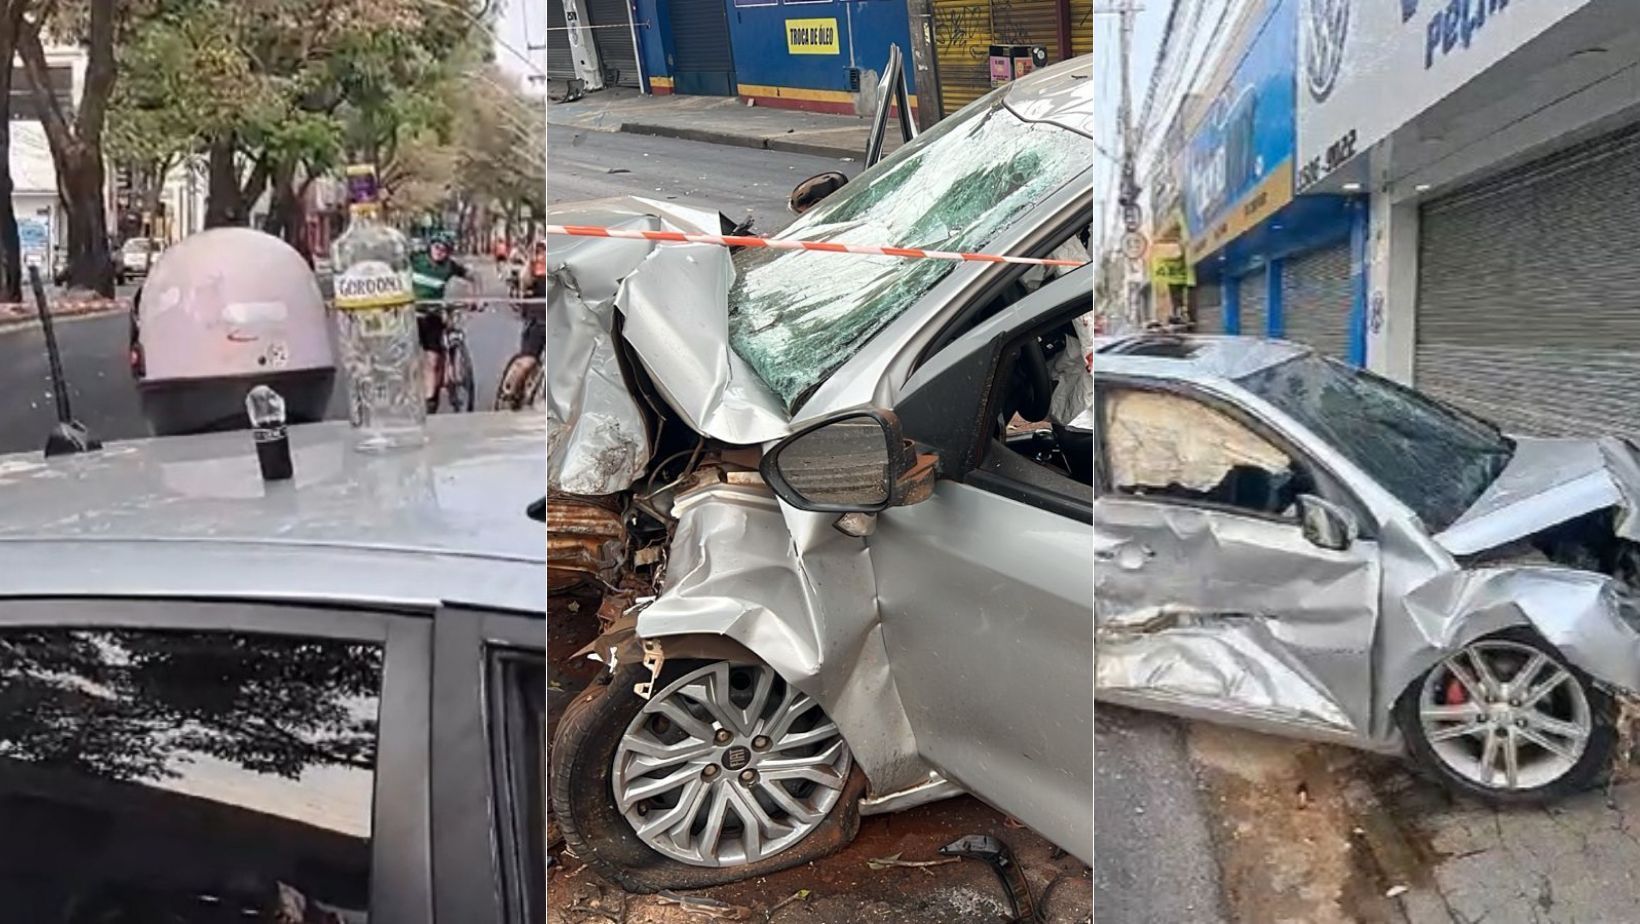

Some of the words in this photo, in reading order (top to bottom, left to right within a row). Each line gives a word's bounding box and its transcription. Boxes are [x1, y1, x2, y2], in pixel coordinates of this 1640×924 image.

[790, 28, 809, 45] TROCA
[810, 27, 818, 45] DE
[819, 25, 833, 45] ÓLEO
[729, 749, 745, 767] FIAT
